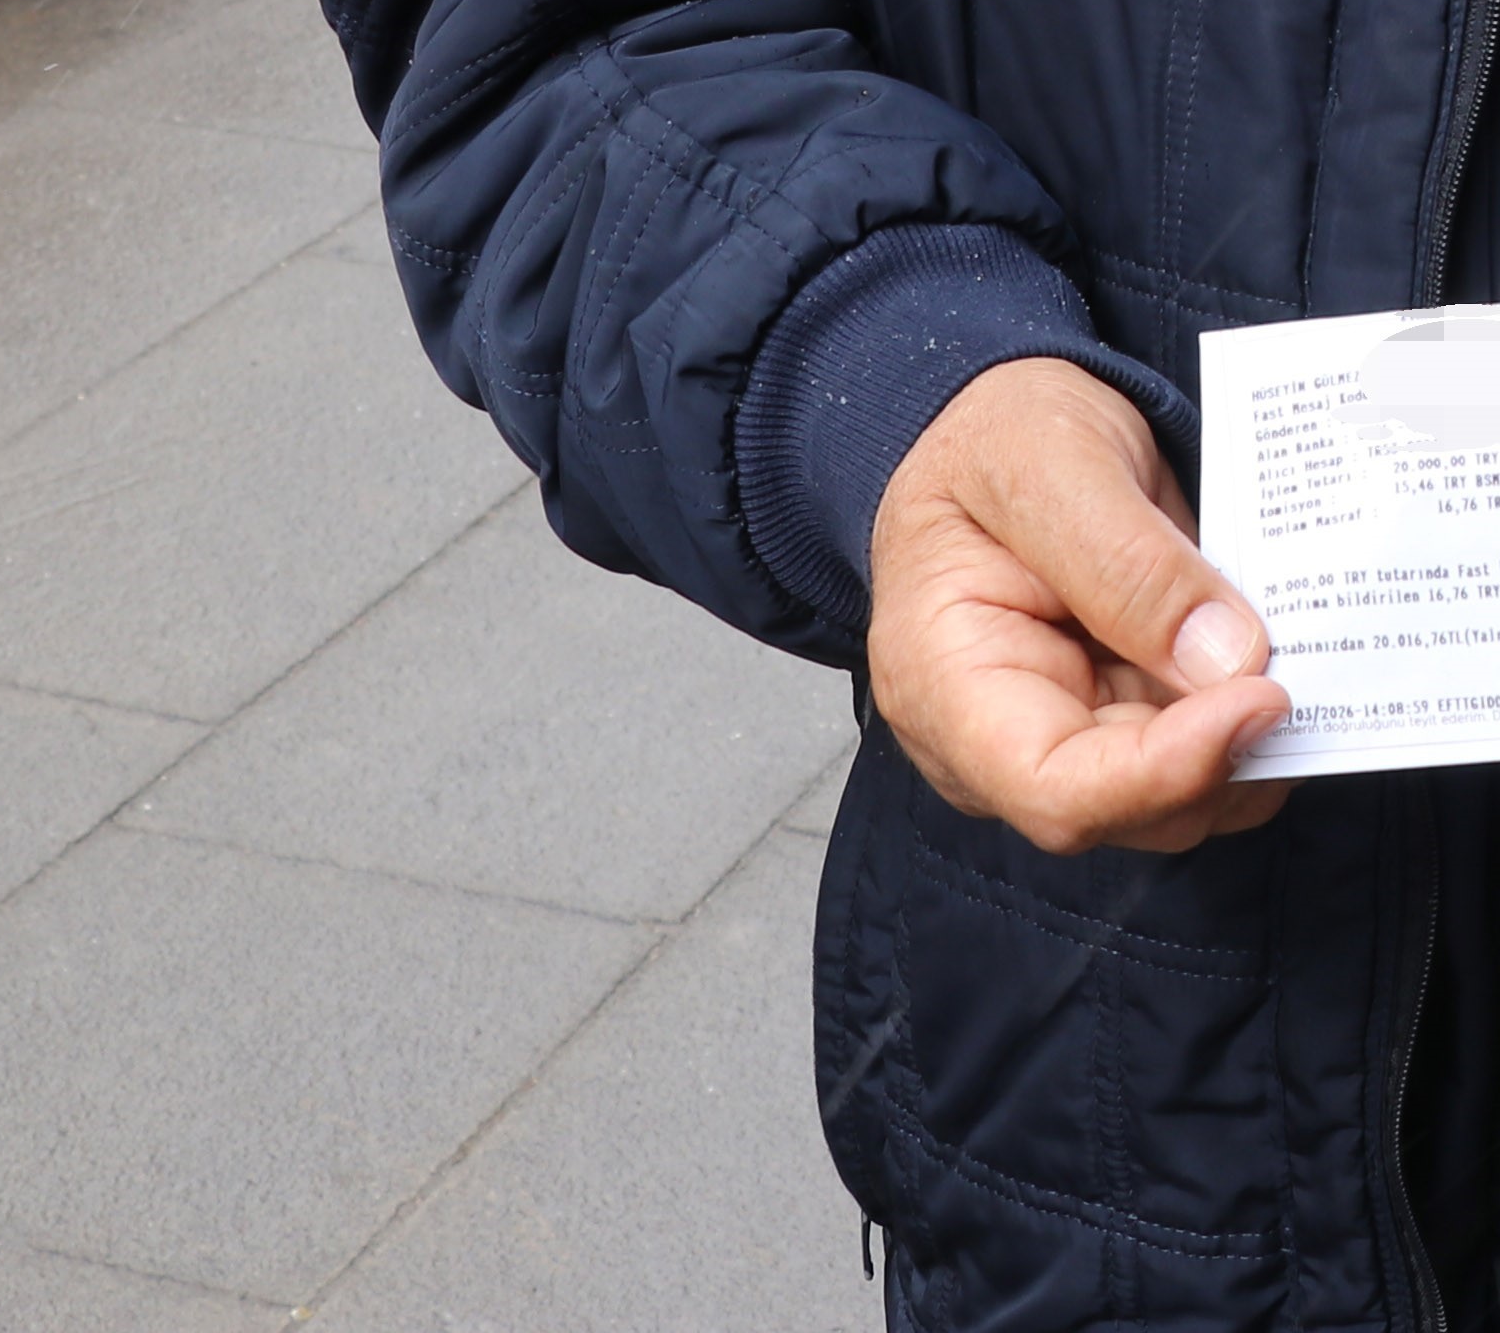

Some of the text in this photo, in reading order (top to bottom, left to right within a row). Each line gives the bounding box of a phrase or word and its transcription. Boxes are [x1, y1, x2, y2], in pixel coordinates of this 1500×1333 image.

[1252, 380, 1306, 402] HÜSEYİN
[1253, 405, 1284, 423] Fast
[1255, 420, 1318, 443] Gönderen
[1257, 436, 1334, 463] Alan Banka
[1304, 456, 1343, 472] Hesap
[1393, 454, 1466, 474] 20.000,00
[1476, 452, 1498, 465] TRY
[1260, 498, 1321, 519] Komisyon
[1394, 478, 1435, 495] 15,46
[1444, 475, 1467, 490] TRY
[1262, 521, 1307, 539] Toplam
[1316, 508, 1361, 527] Masraf
[1438, 496, 1477, 515] 16,76
[1344, 570, 1367, 584] TRY
[1377, 564, 1449, 582] tutarında
[1458, 561, 1490, 578] Fast
[1337, 588, 1420, 608] bildirilen
[1428, 586, 1468, 604] 16,76
[1477, 584, 1500, 599] TRY
[1287, 699, 1429, 725] /03/2026-14:08:59
